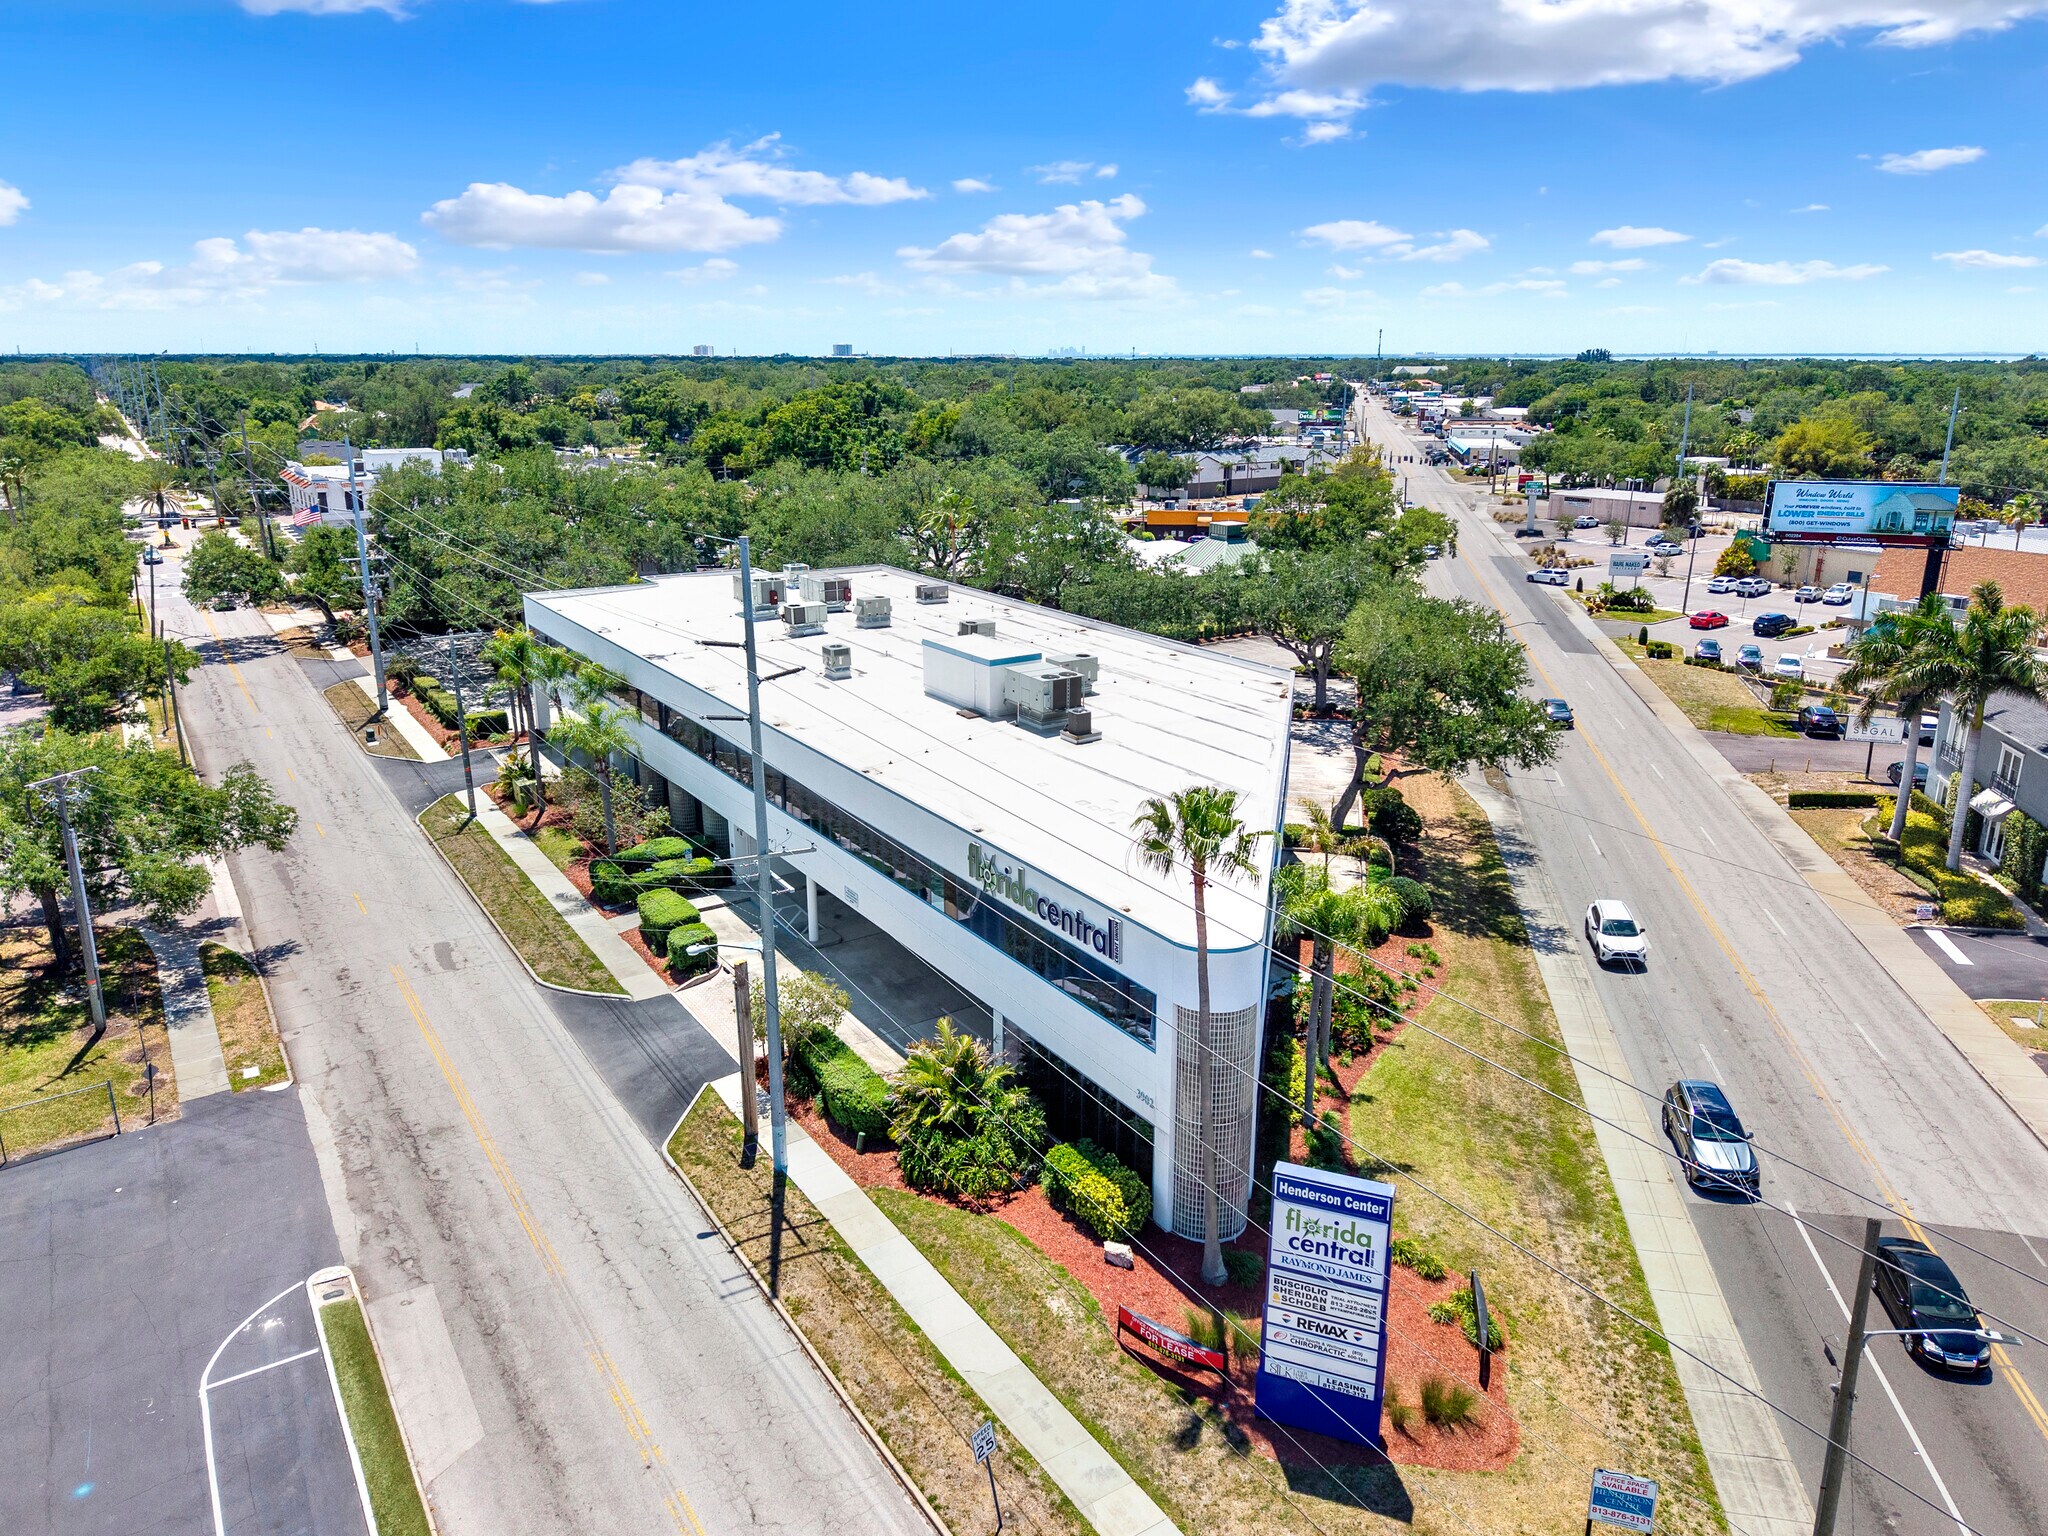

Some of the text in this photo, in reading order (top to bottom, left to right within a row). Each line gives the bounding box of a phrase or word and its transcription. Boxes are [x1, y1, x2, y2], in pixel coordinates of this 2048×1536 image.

[1795, 488, 1855, 499] Window World
[1777, 509, 1815, 518] LOWER
[1853, 726, 1895, 737] SEGAL
[1136, 1088, 1155, 1109] 3902
[1279, 1181, 1385, 1215] Henderson Center
[1285, 1207, 1372, 1249] florida
[1288, 1236, 1371, 1268] central
[1281, 1255, 1372, 1284] RAYMOND JAMES
[1273, 1277, 1328, 1297] BUSCIGLIO
[1273, 1285, 1327, 1304] SHERIDAN
[1281, 1294, 1327, 1312] SCHOEB
[1331, 1295, 1346, 1303] TRIAL
[1140, 1326, 1195, 1361] FOR LEASE
[1147, 1340, 1185, 1363] 813-876-3131
[1187, 1345, 1206, 1357] FLOOR
[1289, 1337, 1346, 1358] CHIROPRACTIC
[1269, 1362, 1293, 1379] SIK
[1322, 1383, 1369, 1400] 813-876-3131
[1326, 1377, 1367, 1394] LEASING
[973, 1424, 992, 1442] SPEED
[976, 1431, 991, 1447] LIMIT
[976, 1436, 994, 1460] 25
[1601, 1475, 1649, 1490] OFFICE SPACE
[1601, 1481, 1649, 1496] AVAILABLE
[1595, 1487, 1653, 1506] HENDERSON
[1604, 1496, 1642, 1511] CENTRE
[1591, 1506, 1651, 1526] 813-876-3131
